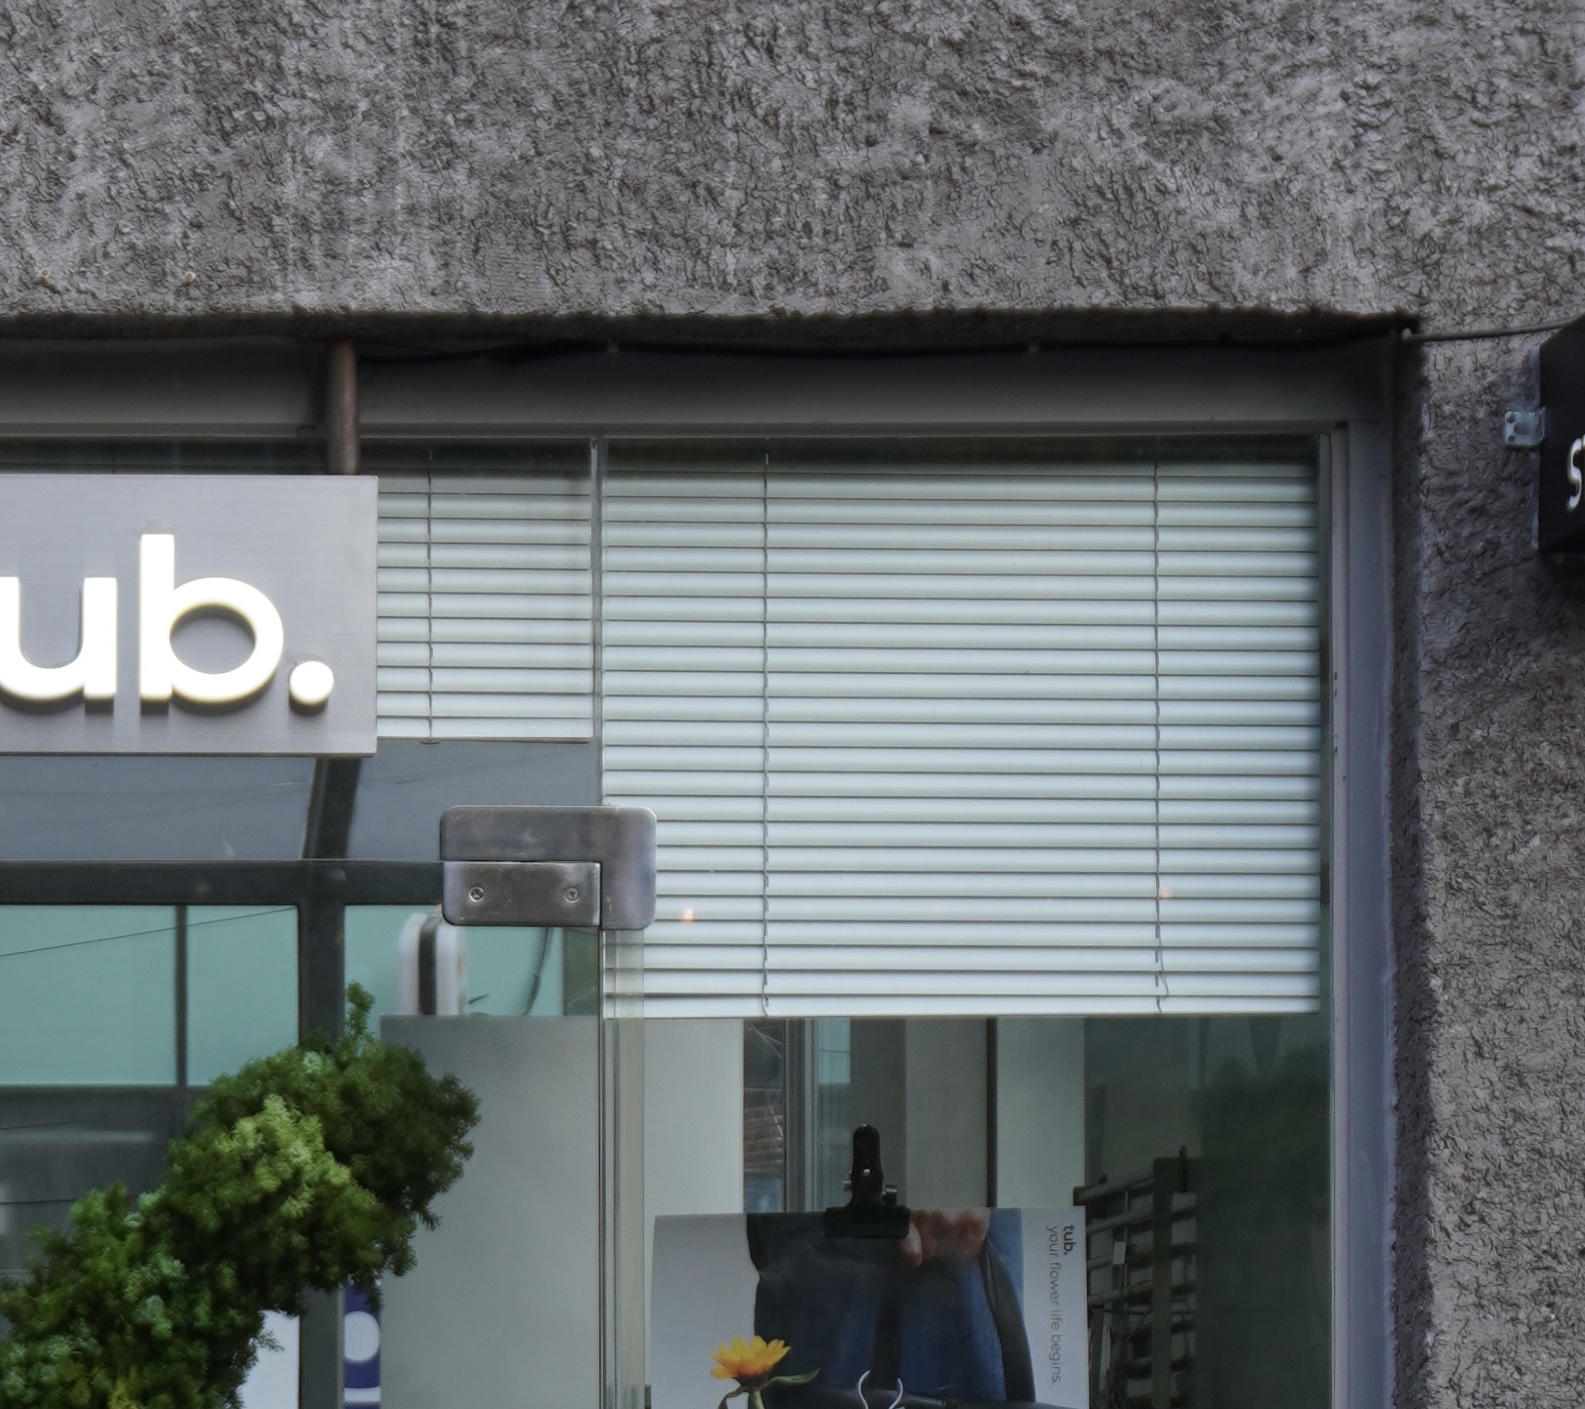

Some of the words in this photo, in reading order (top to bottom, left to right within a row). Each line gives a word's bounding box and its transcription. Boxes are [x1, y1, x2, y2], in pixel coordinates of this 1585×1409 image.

[1046, 1225, 1059, 1257] your
[1062, 1223, 1077, 1256] tub.
[1049, 1262, 1062, 1306] flower
[1050, 1309, 1063, 1331] life
